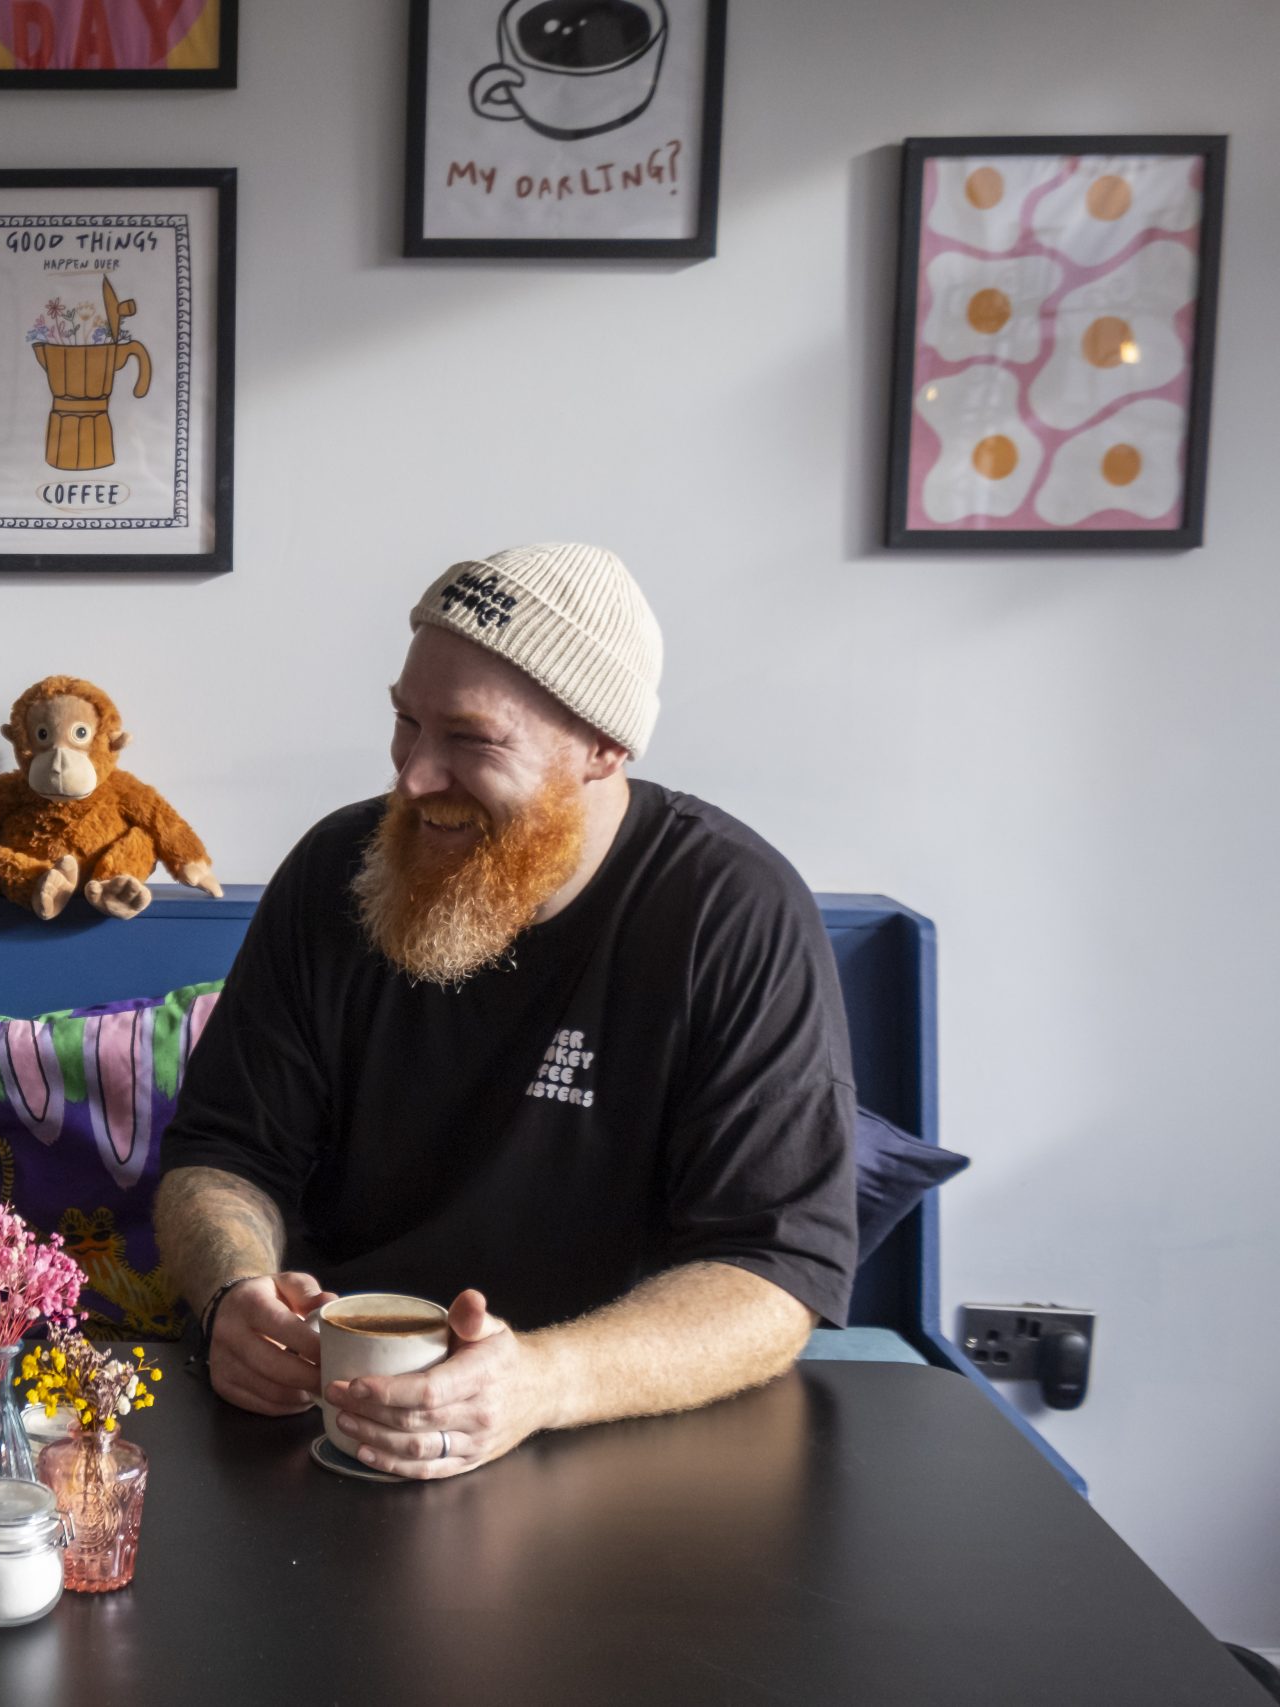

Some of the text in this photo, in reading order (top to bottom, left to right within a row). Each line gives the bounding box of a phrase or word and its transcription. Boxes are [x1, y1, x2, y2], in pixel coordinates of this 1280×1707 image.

[10, 0, 183, 69] DAY
[447, 140, 682, 200] MY DARLING?
[6, 231, 63, 253] GOOD
[43, 257, 120, 271] HAPPEN OVER
[42, 484, 119, 505] COFFEE
